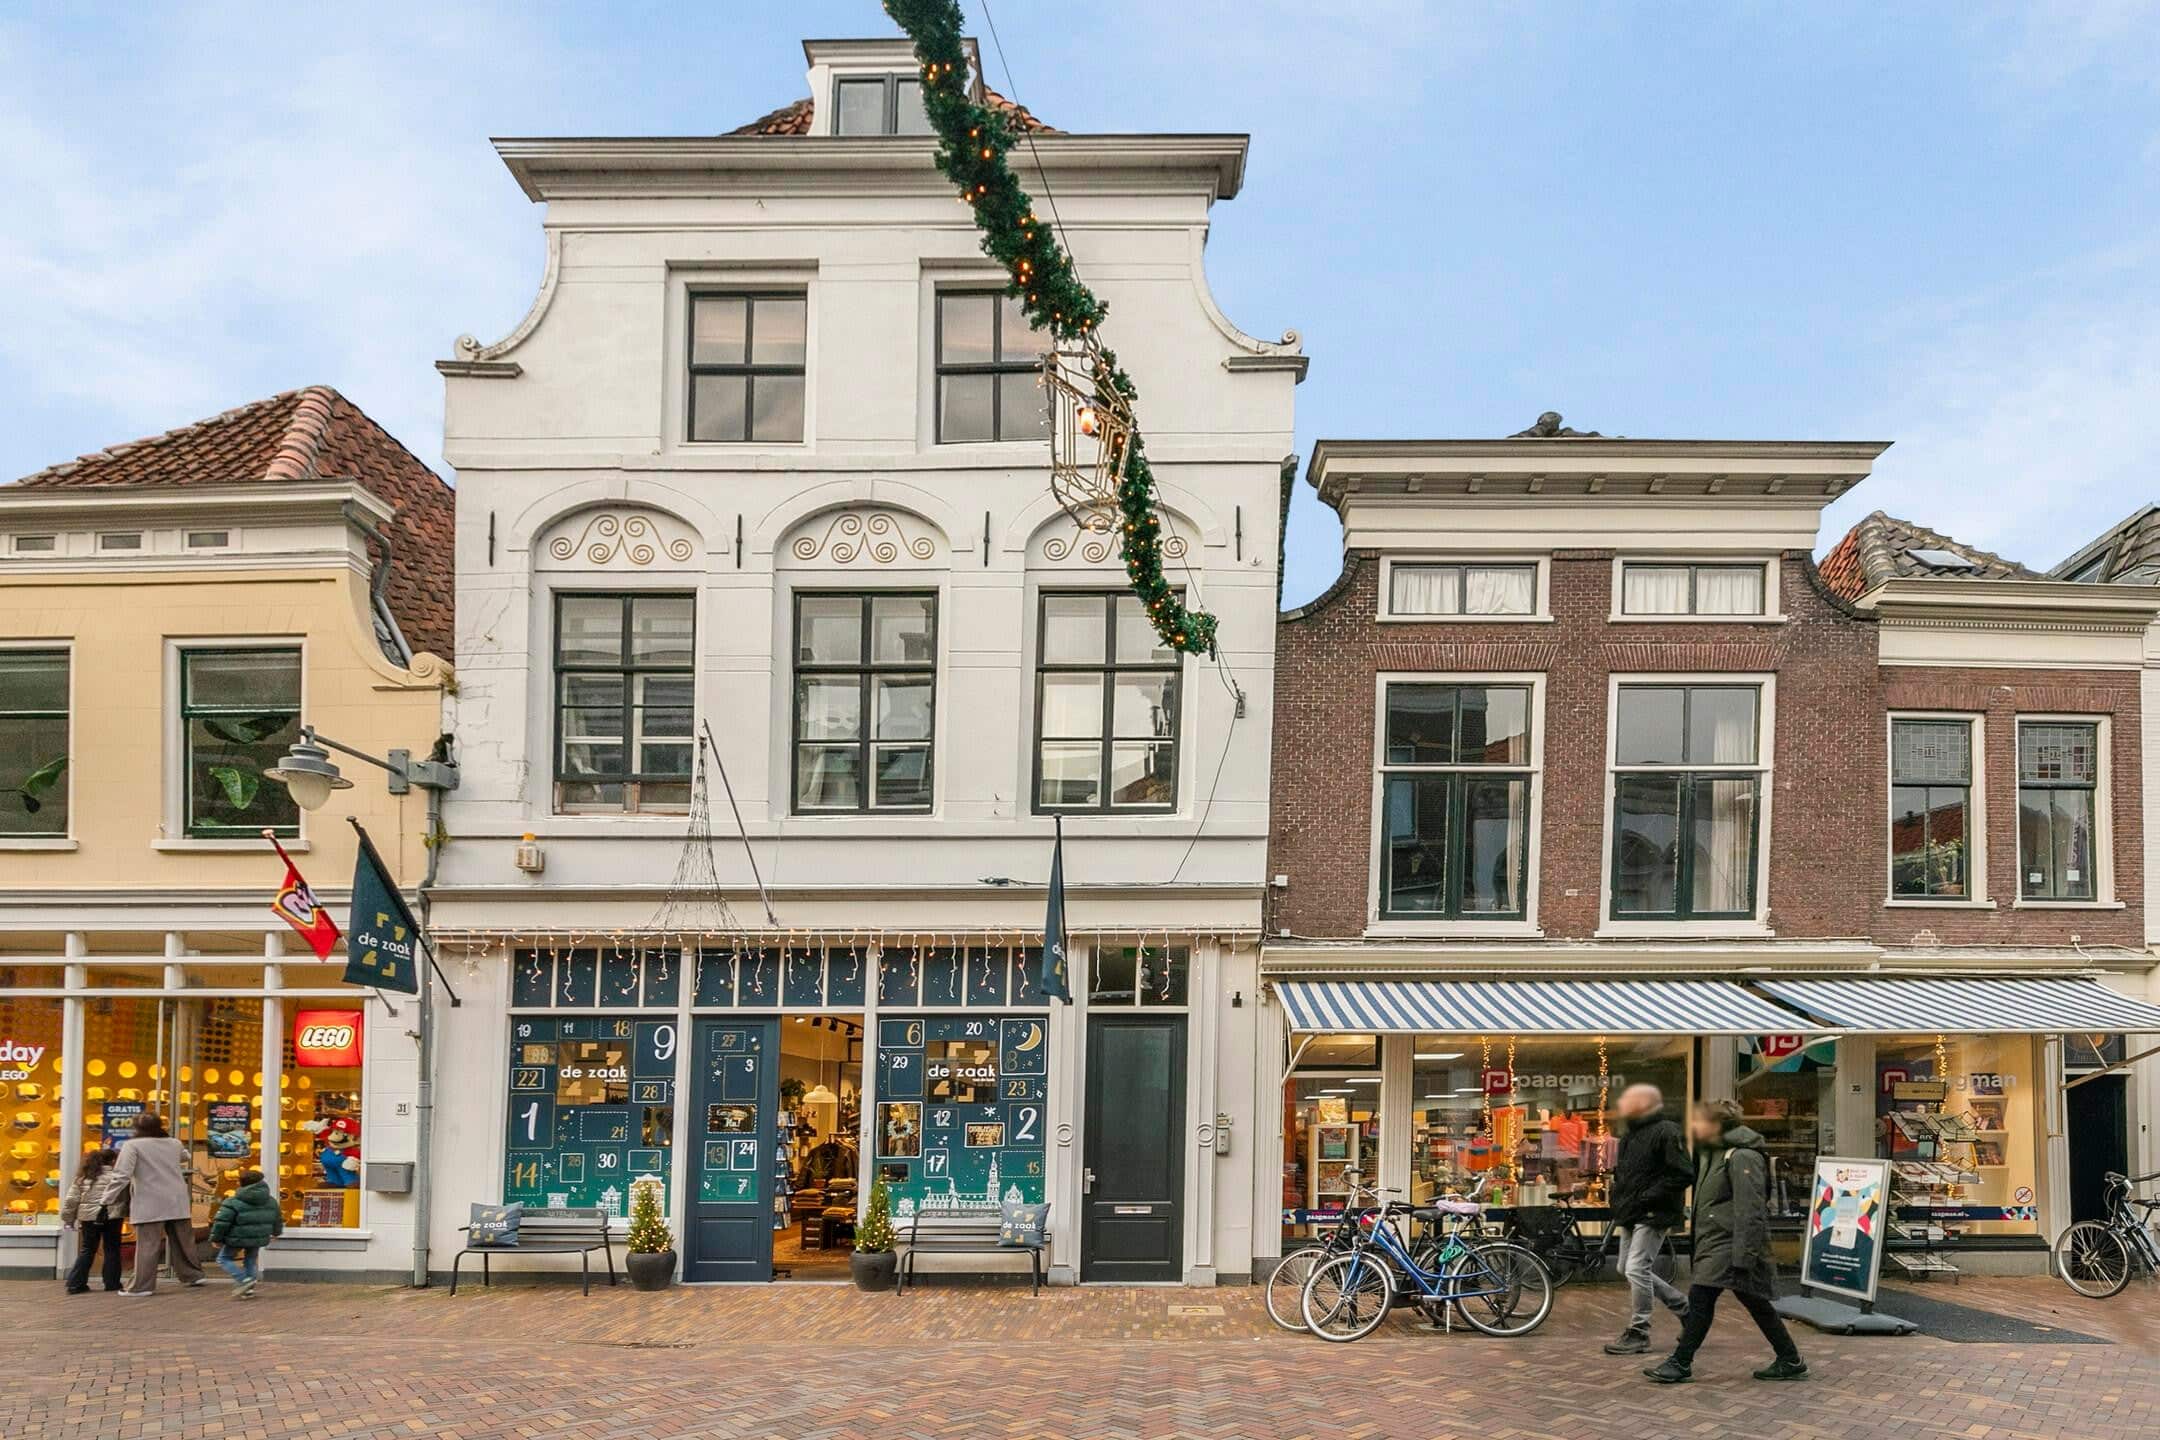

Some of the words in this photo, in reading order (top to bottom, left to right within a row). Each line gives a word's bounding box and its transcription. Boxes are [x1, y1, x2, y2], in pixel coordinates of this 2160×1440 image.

[358, 932, 377, 947] de
[382, 939, 410, 956] zaak
[517, 1024, 531, 1037] 19
[563, 1022, 574, 1034] 11
[613, 1020, 630, 1037] 18
[906, 1023, 921, 1045] 6
[965, 1022, 983, 1036] 20
[301, 1027, 352, 1049] LEGO
[653, 1025, 676, 1060] 9
[744, 1058, 754, 1072] 3
[892, 1056, 908, 1069] 29
[1005, 1050, 1018, 1071] 8
[517, 1070, 538, 1087] 22
[560, 1065, 583, 1078] de
[588, 1065, 627, 1078] zaak
[928, 1064, 950, 1077] de
[956, 1064, 996, 1077] zaak
[1007, 1080, 1027, 1097] 23
[1516, 1074, 1625, 1092] paagman
[641, 1085, 658, 1099] 28
[108, 1105, 141, 1113] GRATIS
[397, 1104, 407, 1113] 31
[521, 1102, 538, 1141] 1
[933, 1110, 951, 1127] 12
[1015, 1107, 1037, 1140] 2
[610, 1126, 624, 1139] 21
[708, 1146, 725, 1164] 13
[739, 1142, 754, 1156] 24
[598, 1153, 617, 1168] 30
[649, 1153, 659, 1169] 4
[927, 1155, 946, 1173] 17
[1026, 1161, 1040, 1174] 15
[512, 1162, 537, 1188] 14
[737, 1178, 748, 1194] 7
[470, 1221, 481, 1230] de
[484, 1220, 508, 1230] zaak
[1014, 1222, 1036, 1230] zaak
